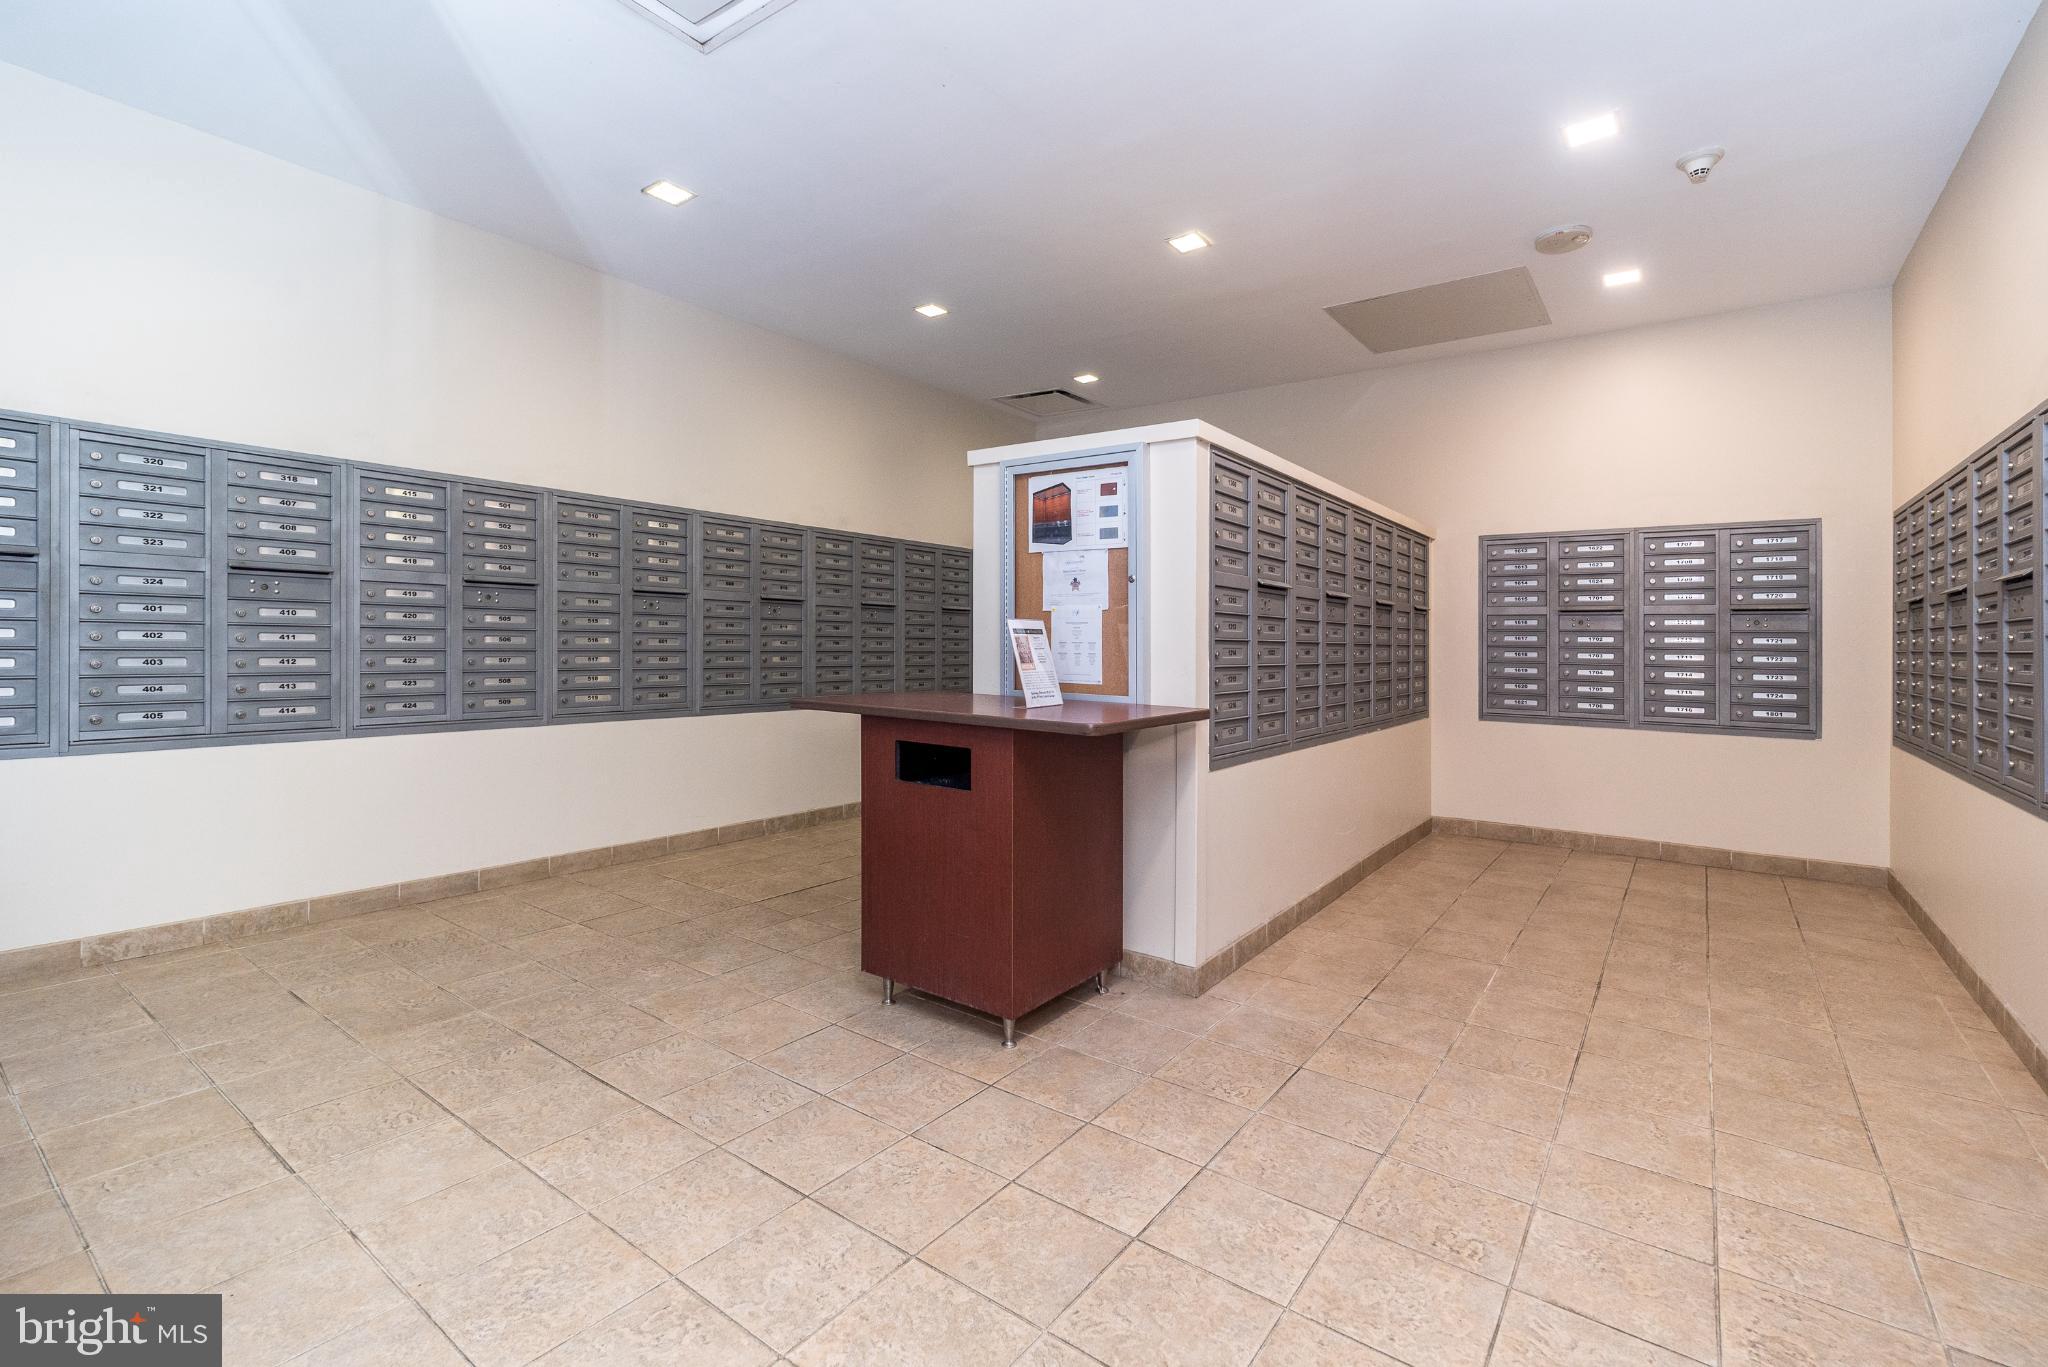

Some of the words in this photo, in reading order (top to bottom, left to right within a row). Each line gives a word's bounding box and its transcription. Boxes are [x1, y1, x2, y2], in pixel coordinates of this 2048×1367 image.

[142, 457, 164, 466] 320
[280, 474, 298, 483] 318
[142, 484, 164, 493] 321
[402, 490, 418, 498] 415
[279, 499, 297, 507] 407
[142, 511, 164, 520] 322
[402, 512, 418, 520] 416
[279, 524, 297, 532] 408
[142, 538, 164, 547] 323
[279, 548, 297, 556] 409
[142, 685, 164, 693] 404
[142, 712, 164, 720] 405
